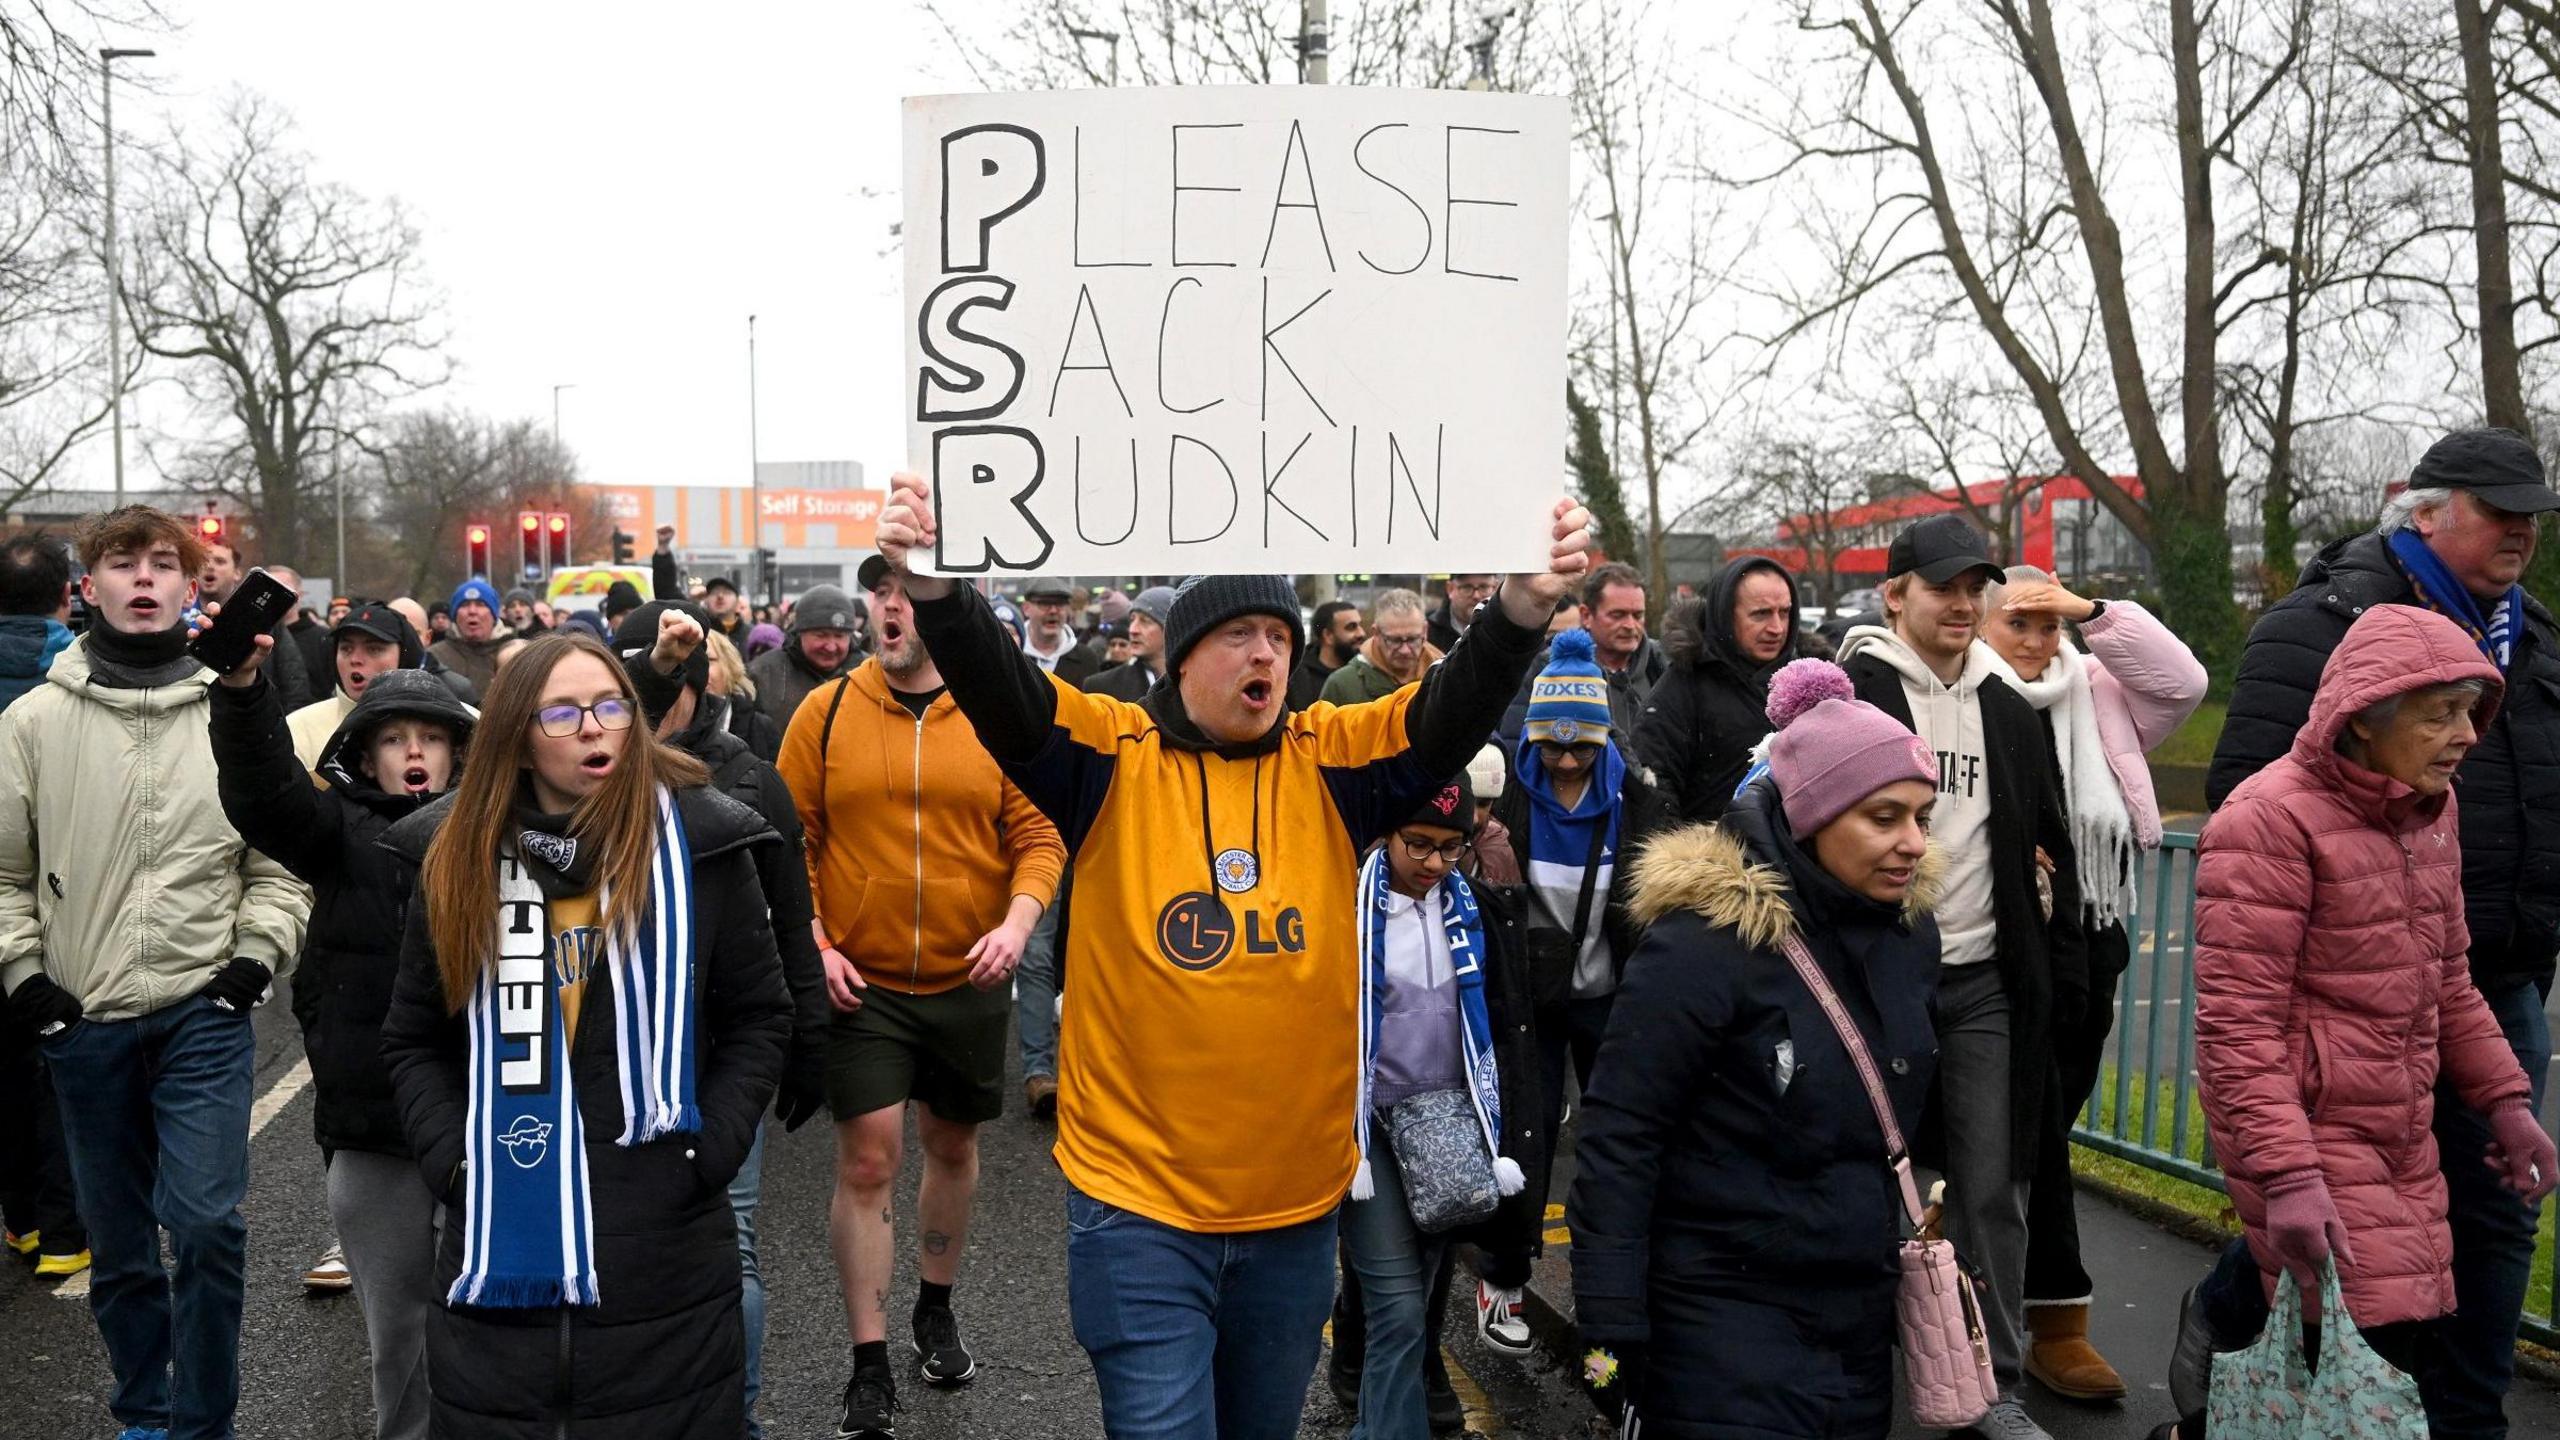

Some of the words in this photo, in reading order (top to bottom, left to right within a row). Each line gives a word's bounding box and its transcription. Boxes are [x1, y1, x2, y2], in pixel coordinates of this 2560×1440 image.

[941, 119, 1520, 282] PLEASE
[917, 275, 1338, 428] SACK
[762, 496, 799, 516] Self
[805, 496, 879, 522] Storage
[932, 423, 1443, 572] RUDKIN
[1535, 682, 1598, 698] FOXES
[1244, 906, 1306, 955] LG
